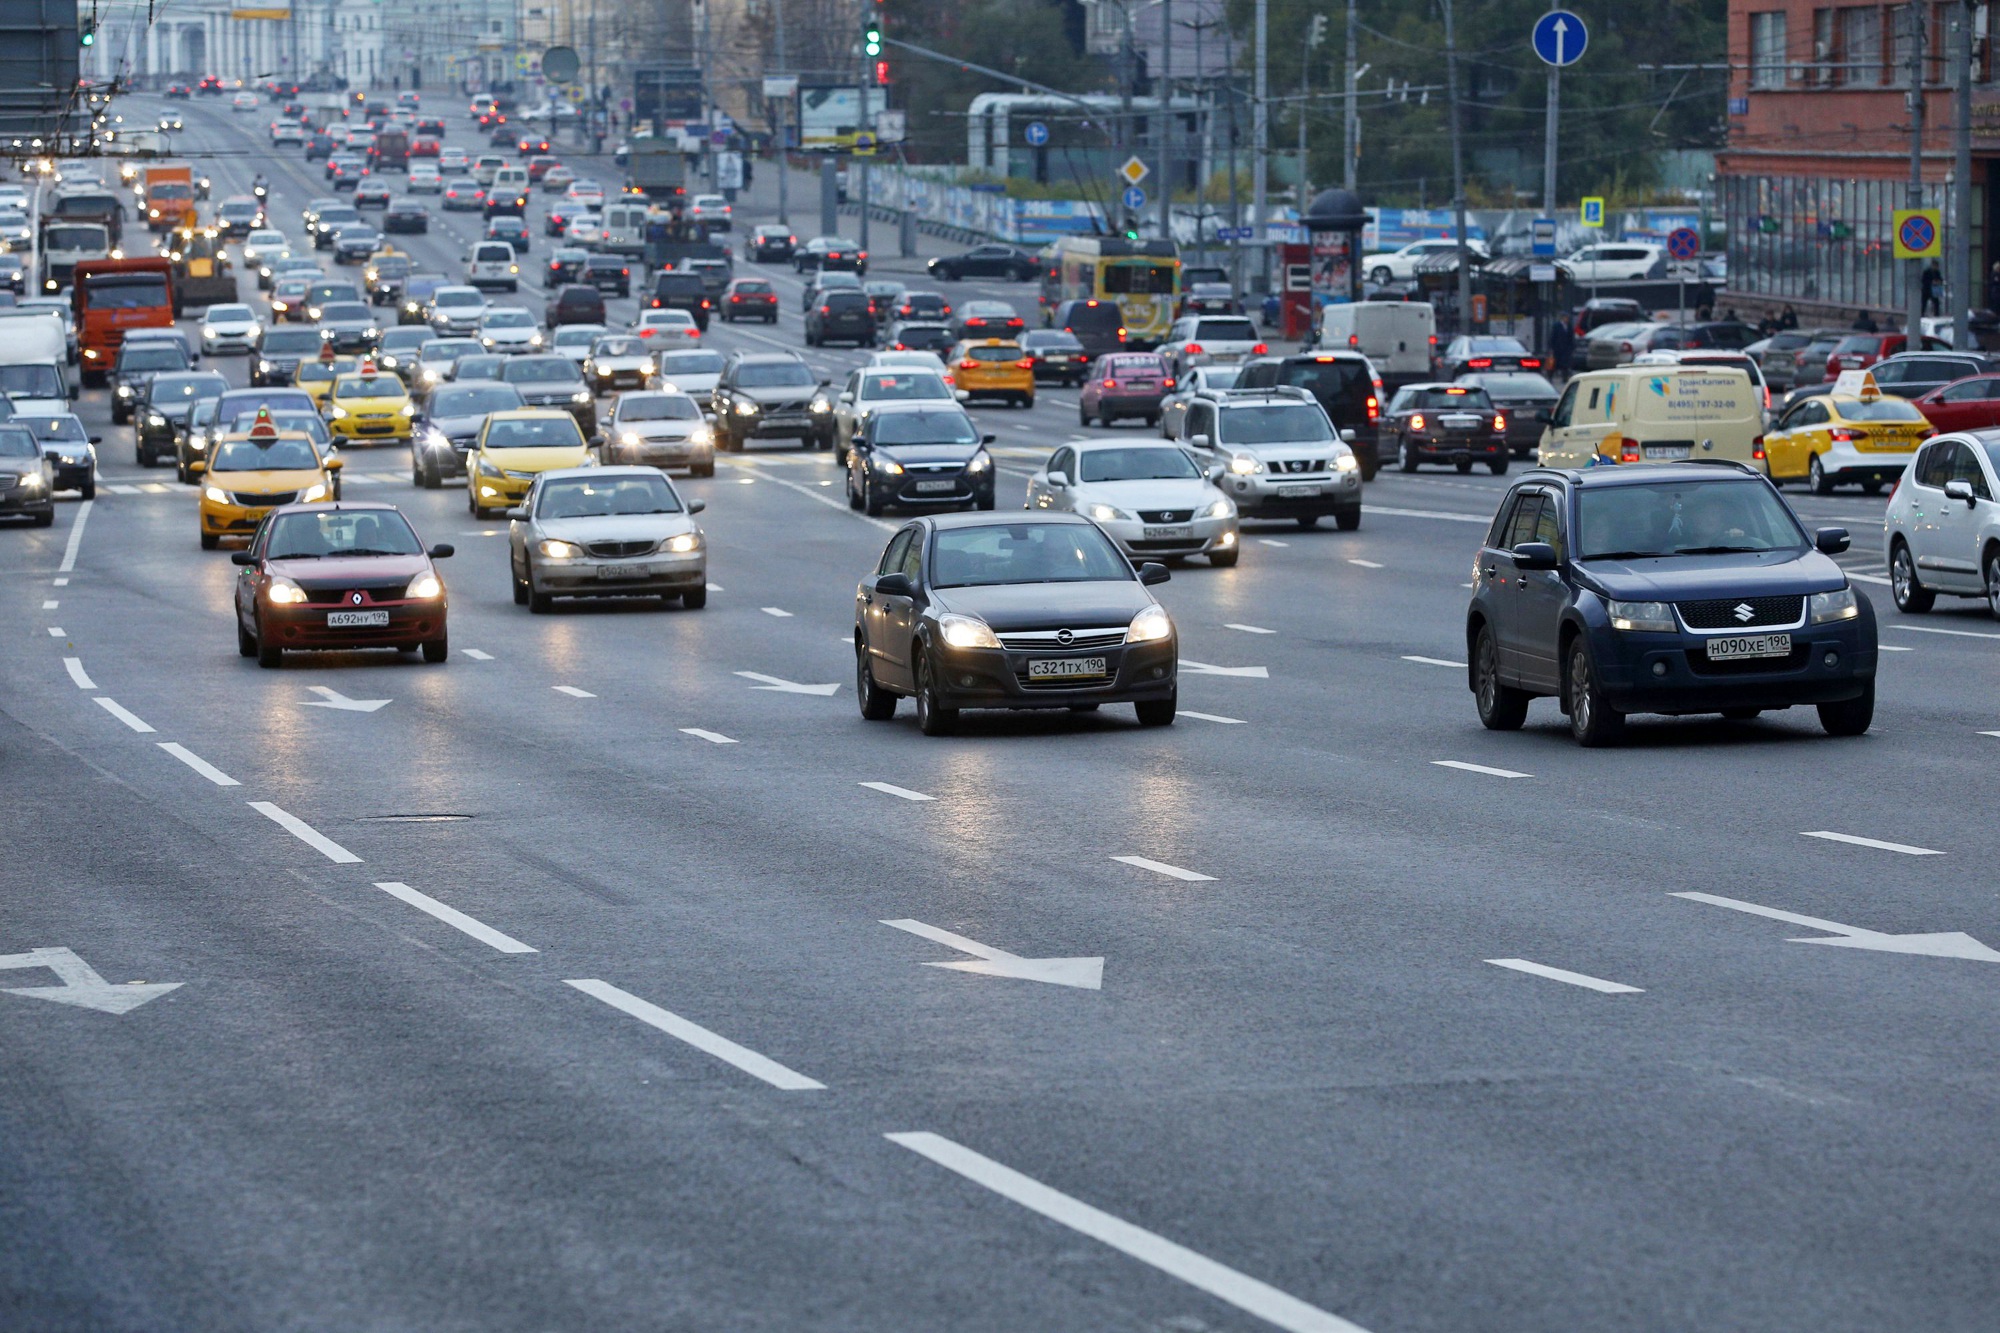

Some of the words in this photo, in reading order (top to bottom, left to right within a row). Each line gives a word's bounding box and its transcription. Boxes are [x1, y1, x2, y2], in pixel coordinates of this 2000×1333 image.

[1678, 379, 1736, 387] ТрансКапитал
[1668, 400, 1694, 409] 8(495)
[1697, 400, 1736, 408] 797-32-00
[331, 613, 369, 624] А692НУ
[1711, 639, 1765, 655] Н090ХЕ
[1767, 636, 1787, 647] 190
[1033, 661, 1082, 675] С321ТХ
[1085, 659, 1103, 669] 190
